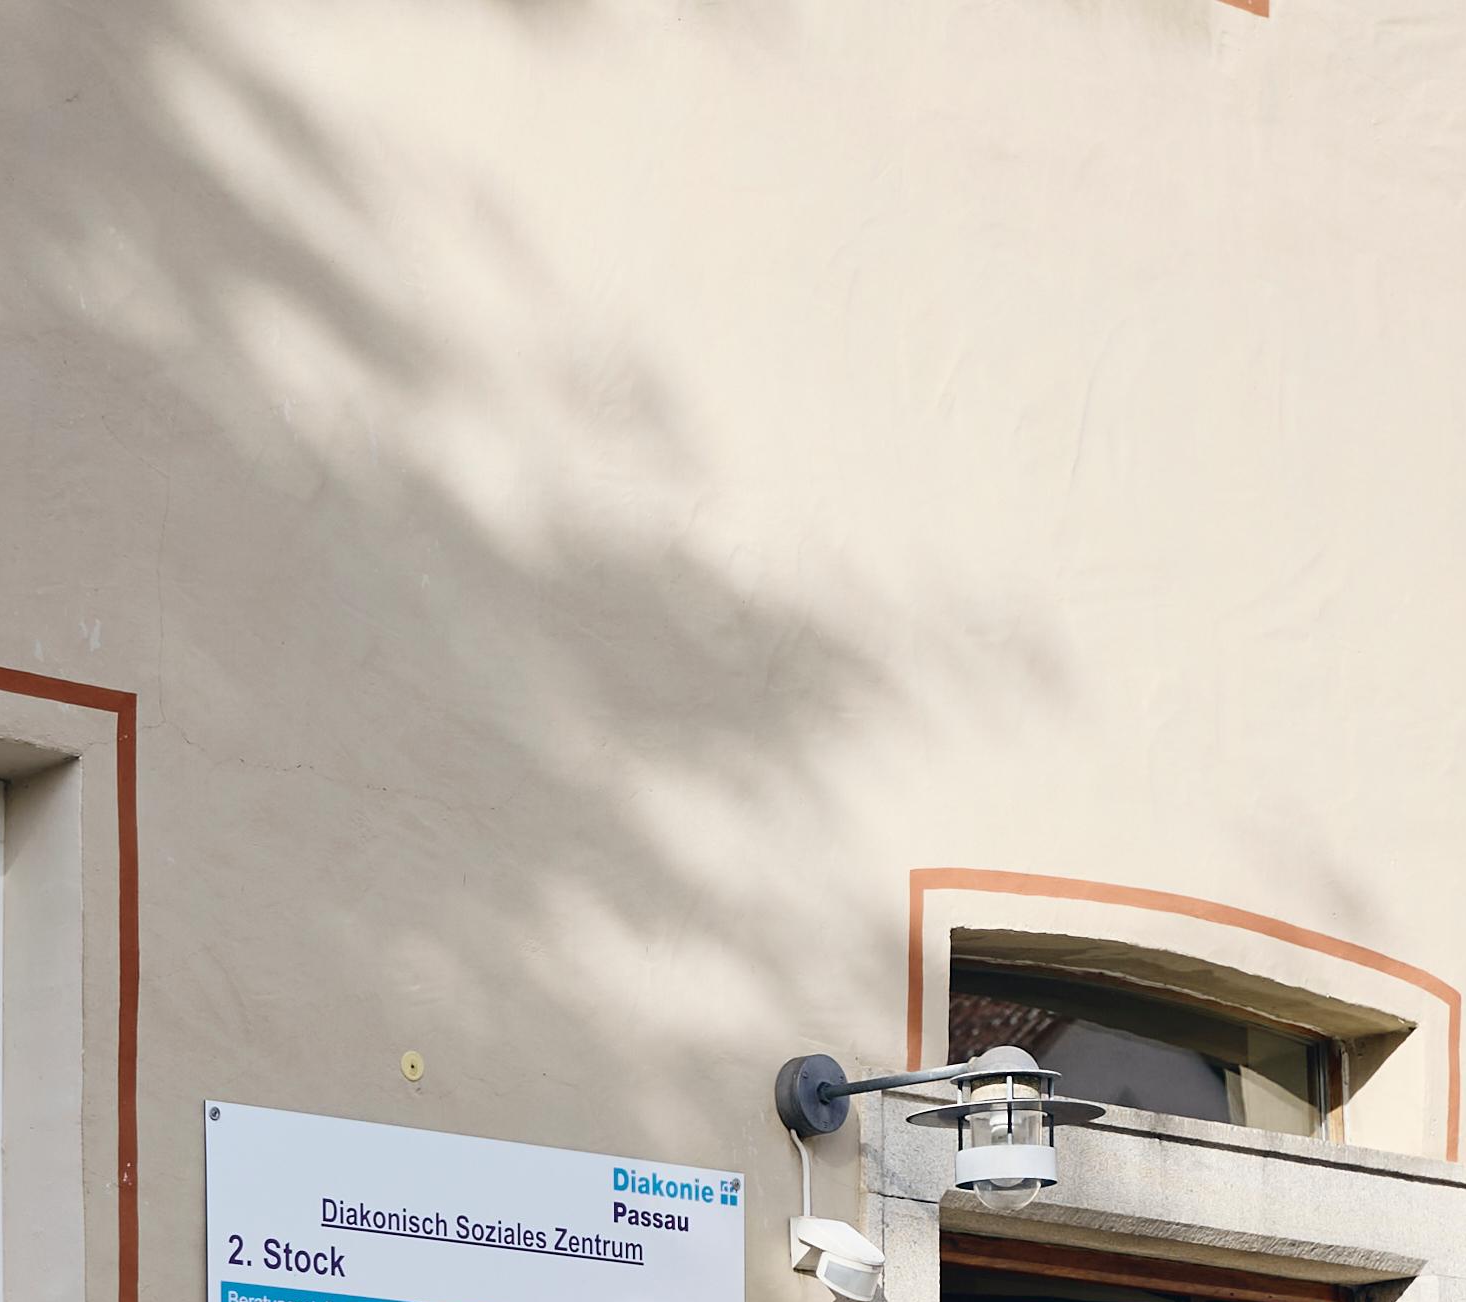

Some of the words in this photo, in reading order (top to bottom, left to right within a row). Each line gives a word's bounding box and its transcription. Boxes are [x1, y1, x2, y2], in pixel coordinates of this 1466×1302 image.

[613, 1167, 714, 1203] Diakonie
[321, 1198, 449, 1237] Diakonisch
[455, 1216, 547, 1250] Soziales
[554, 1228, 644, 1265] Zentrum
[613, 1202, 689, 1233] Passau
[228, 1235, 253, 1266] 2.
[263, 1238, 345, 1277] Stock
